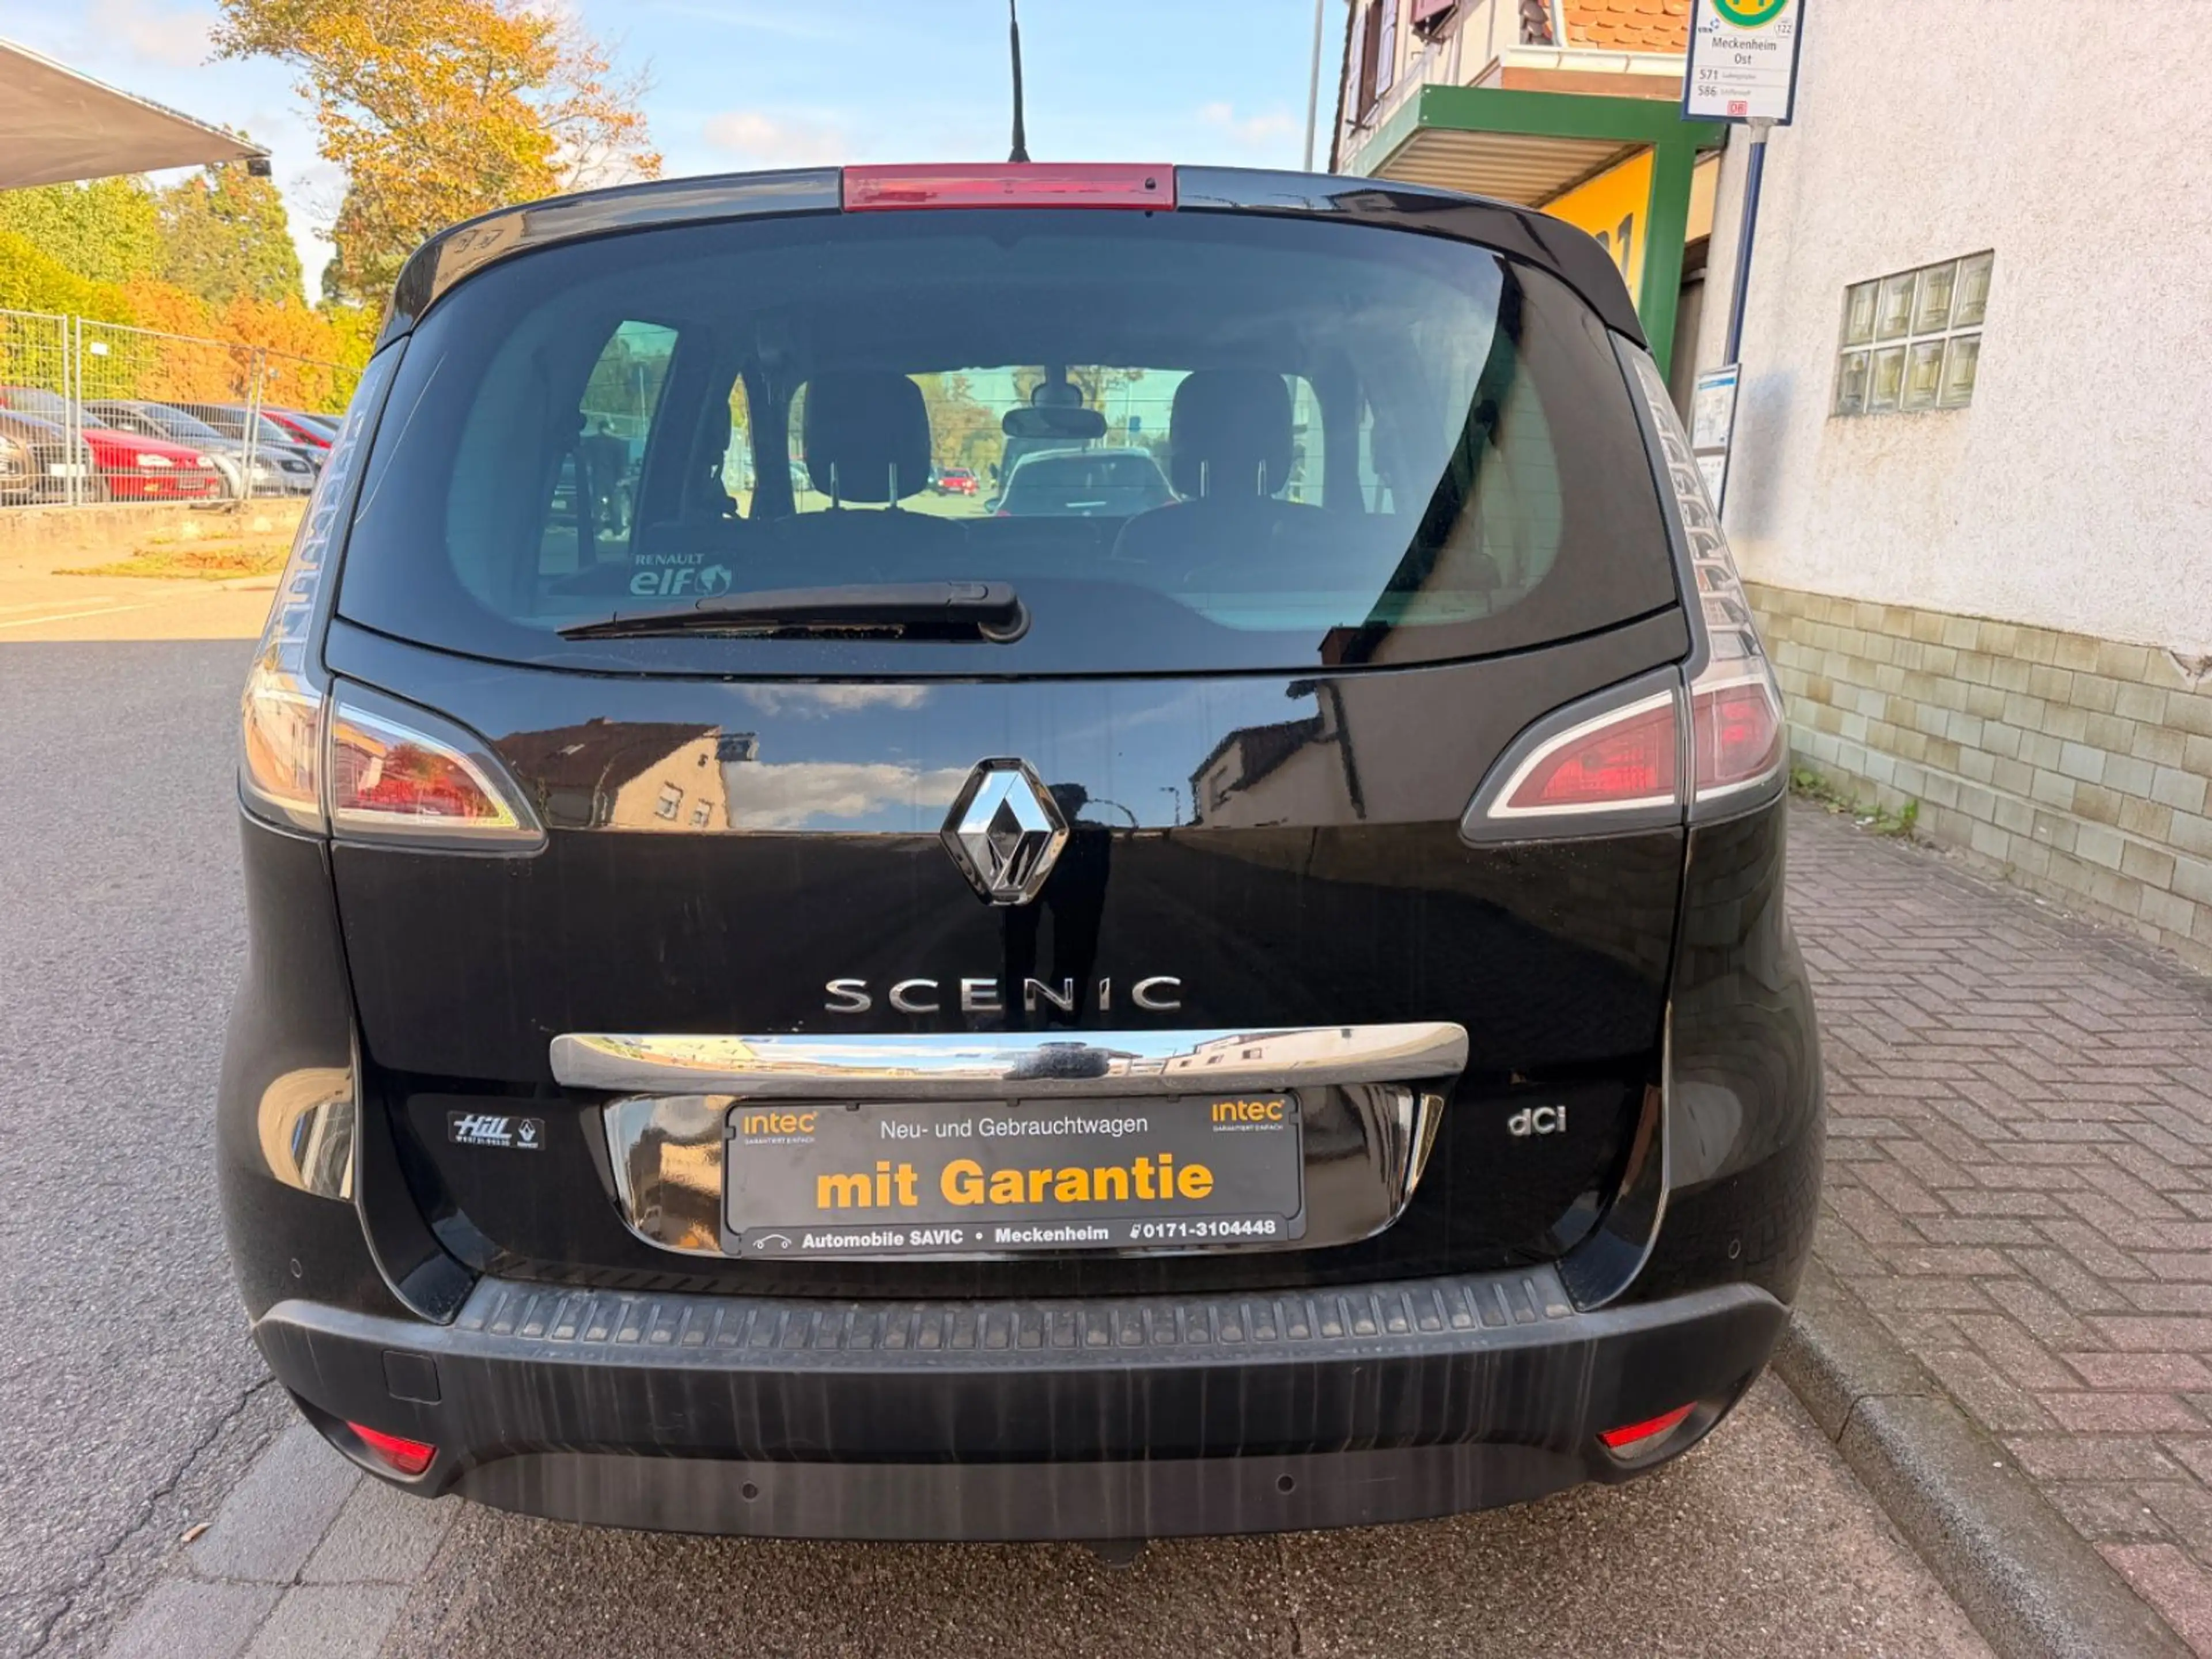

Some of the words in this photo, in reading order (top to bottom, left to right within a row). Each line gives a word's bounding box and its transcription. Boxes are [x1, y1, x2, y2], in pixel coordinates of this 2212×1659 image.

[1712, 37, 1777, 51] Meckenheim
[1734, 53, 1751, 65] Ost
[1699, 69, 1718, 79] 571
[1698, 86, 1717, 96] 586
[635, 553, 704, 565] RENAULT
[630, 568, 695, 595] elf
[825, 976, 1181, 1013] SCENIC
[881, 1120, 929, 1138] Neu-
[935, 1118, 972, 1138] und
[979, 1116, 1148, 1137] Gebrauchtwagen
[817, 1160, 919, 1208] mit
[940, 1153, 1214, 1206] Garantie
[802, 1232, 905, 1249] Automobile
[910, 1229, 964, 1245] SAVIC
[995, 1226, 1109, 1243] Meckenheim
[1143, 1219, 1277, 1238] 0171-3104448
